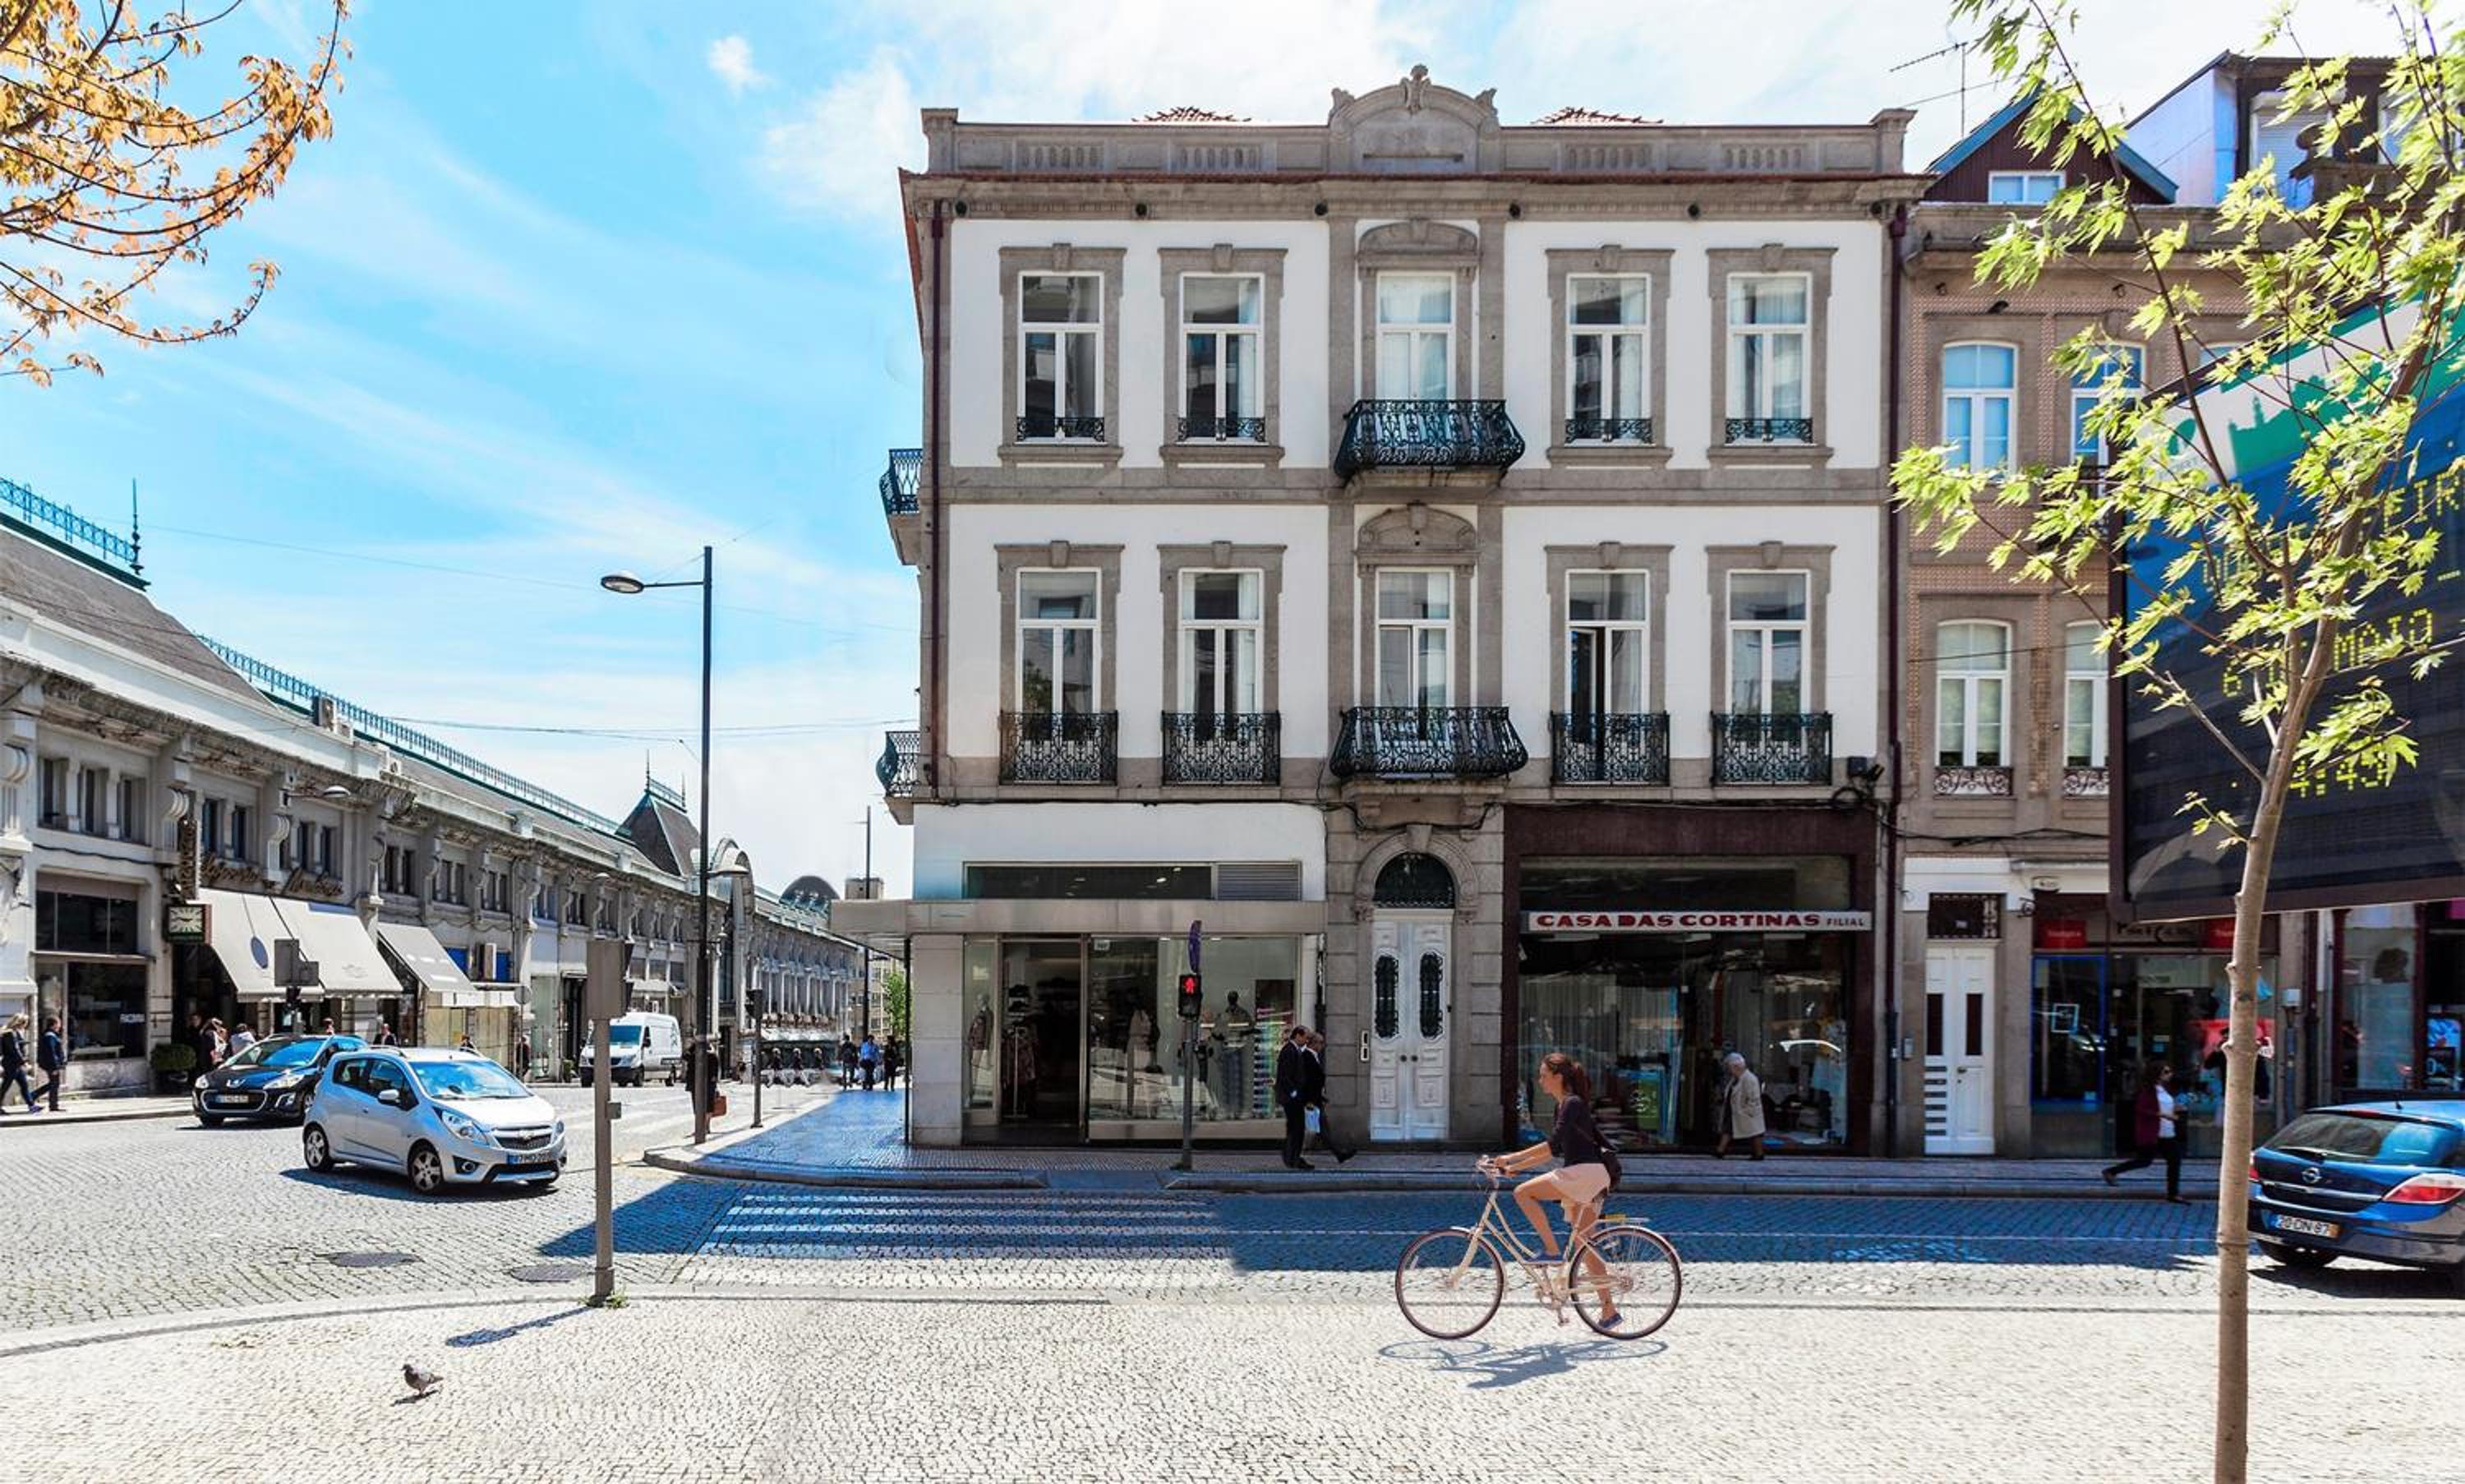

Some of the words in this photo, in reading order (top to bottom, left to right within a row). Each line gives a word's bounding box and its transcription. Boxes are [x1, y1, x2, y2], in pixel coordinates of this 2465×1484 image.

[1537, 915, 1612, 928] CASA
[1617, 915, 1674, 928] DAS
[1679, 914, 1821, 928] CORTINAS
[1827, 917, 1864, 927] FILIAL
